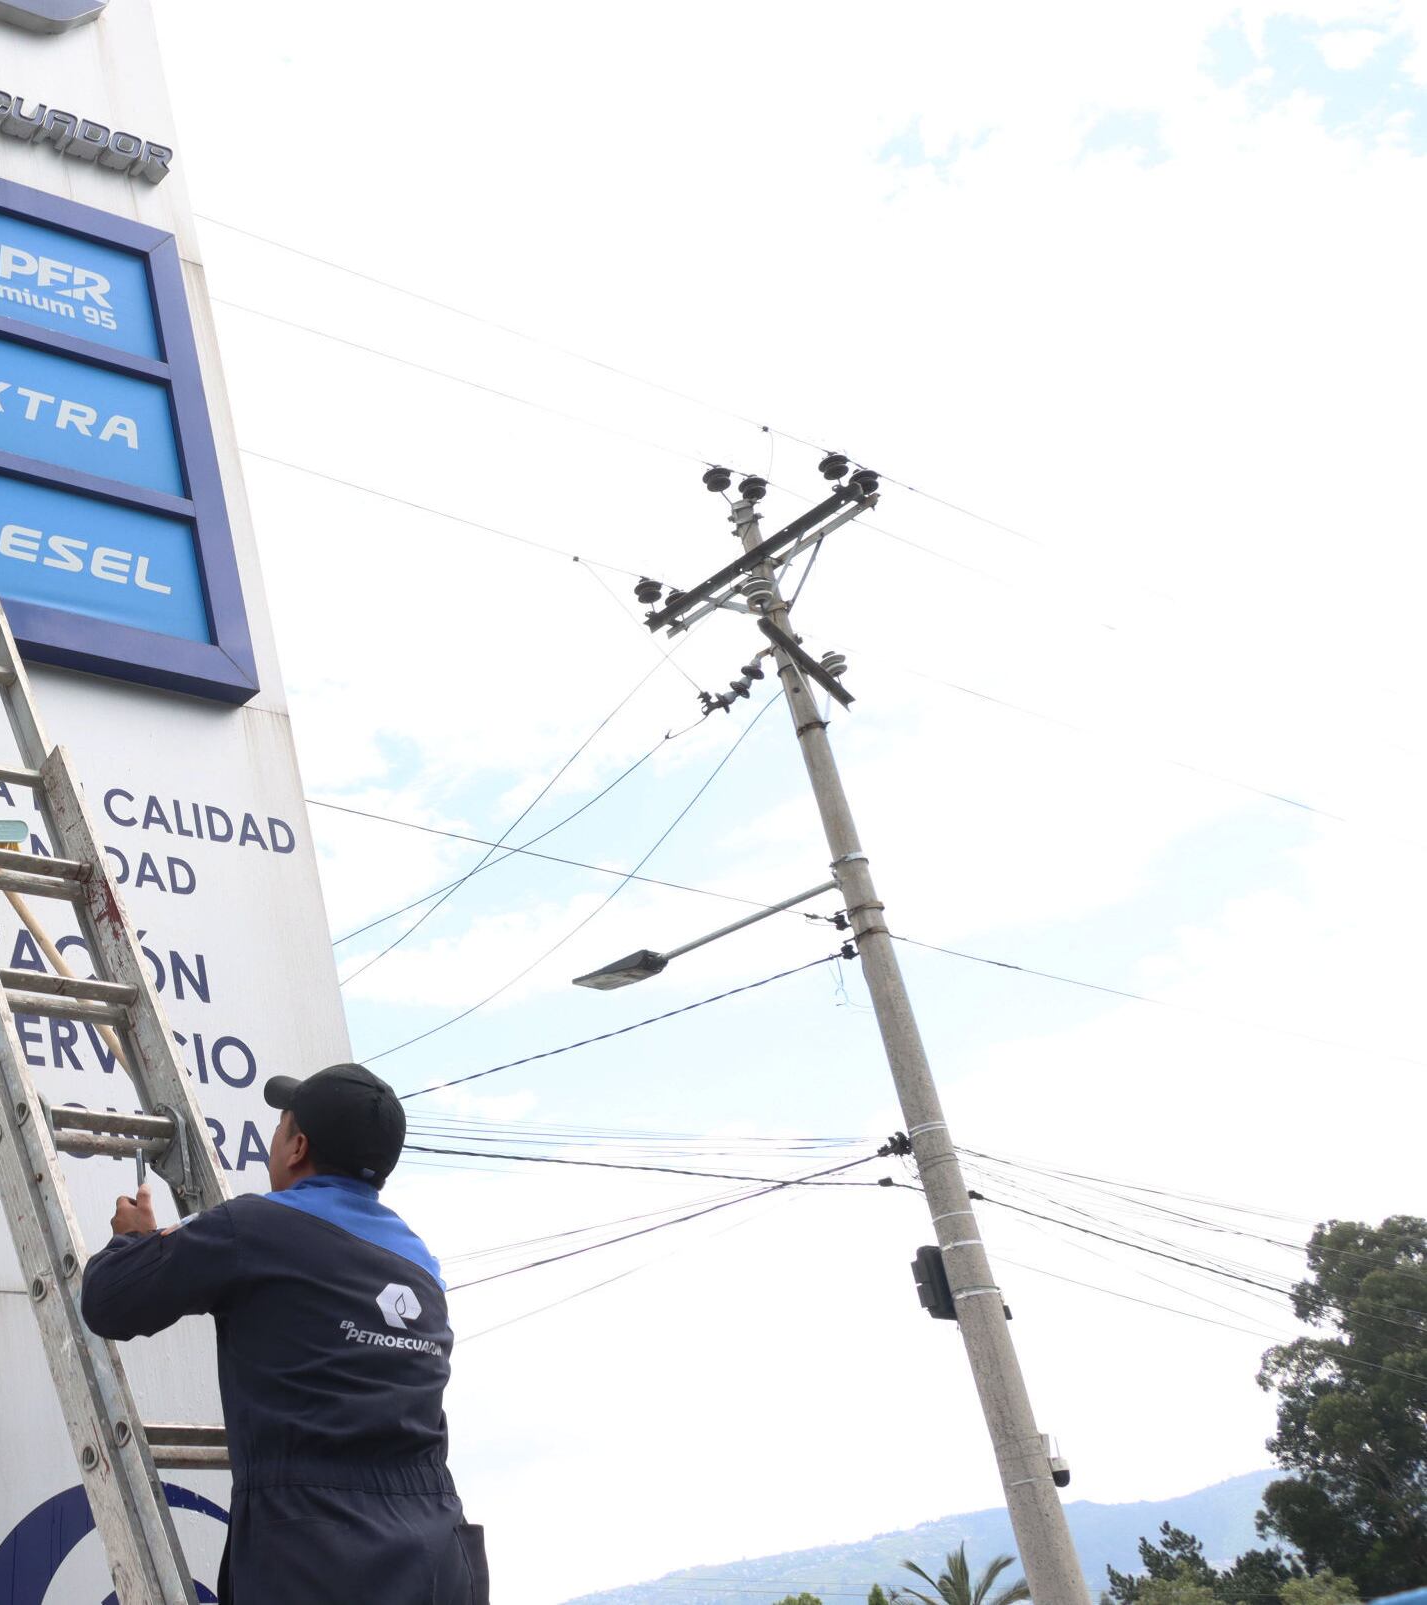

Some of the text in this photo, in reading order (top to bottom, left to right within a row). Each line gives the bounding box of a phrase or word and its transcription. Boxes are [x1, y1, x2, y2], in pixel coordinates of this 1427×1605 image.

[81, 305, 118, 331] 95
[103, 788, 296, 855] CALIDAD
[339, 1320, 355, 1330] EP
